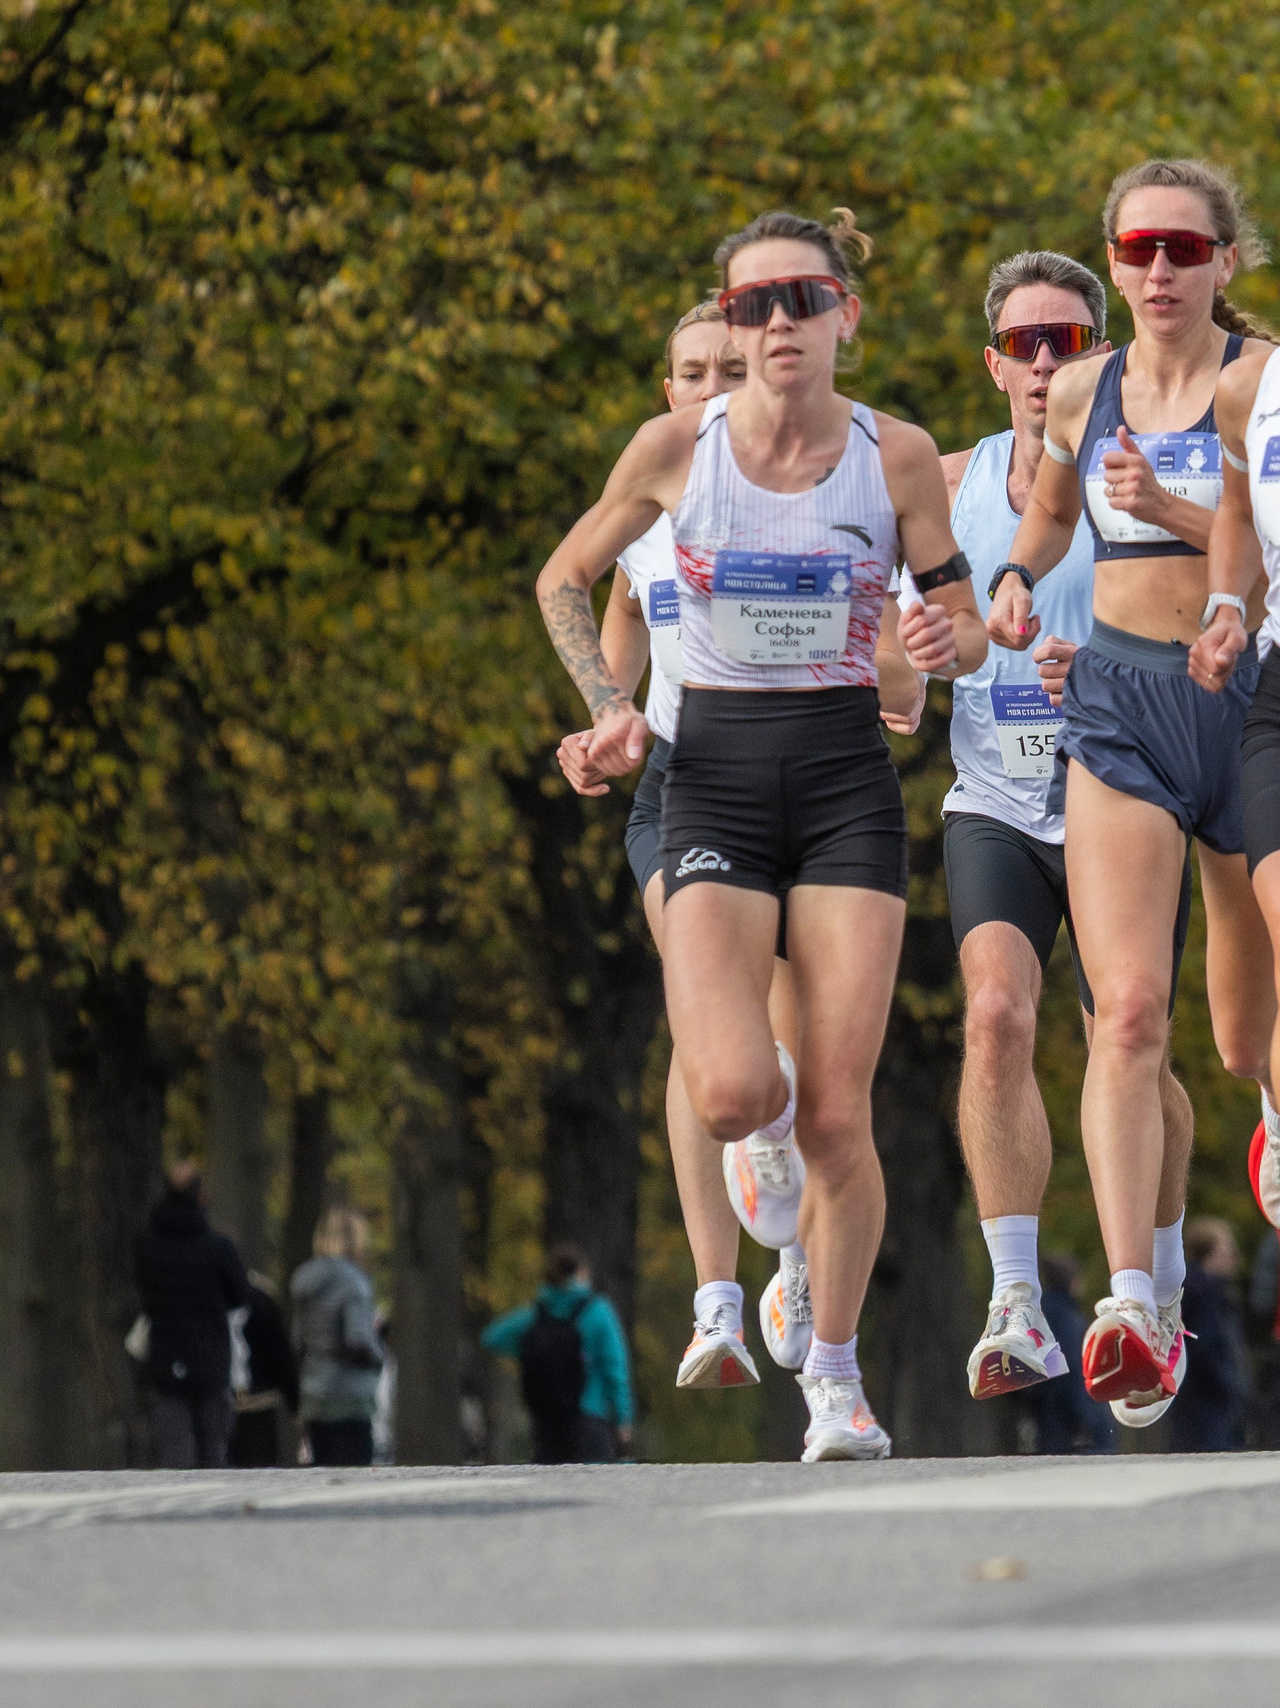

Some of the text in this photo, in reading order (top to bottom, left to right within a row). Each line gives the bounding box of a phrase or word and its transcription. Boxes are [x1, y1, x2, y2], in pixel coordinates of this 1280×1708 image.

[724, 578, 742, 589] МОЯ
[743, 580, 788, 591] СТОЛИЦА
[740, 603, 832, 619] Каменева
[754, 621, 816, 639] Софья
[769, 638, 800, 648] 16008
[1007, 707, 1056, 716] МОЯ СТОЛИЦА
[1015, 734, 1056, 757] 135
